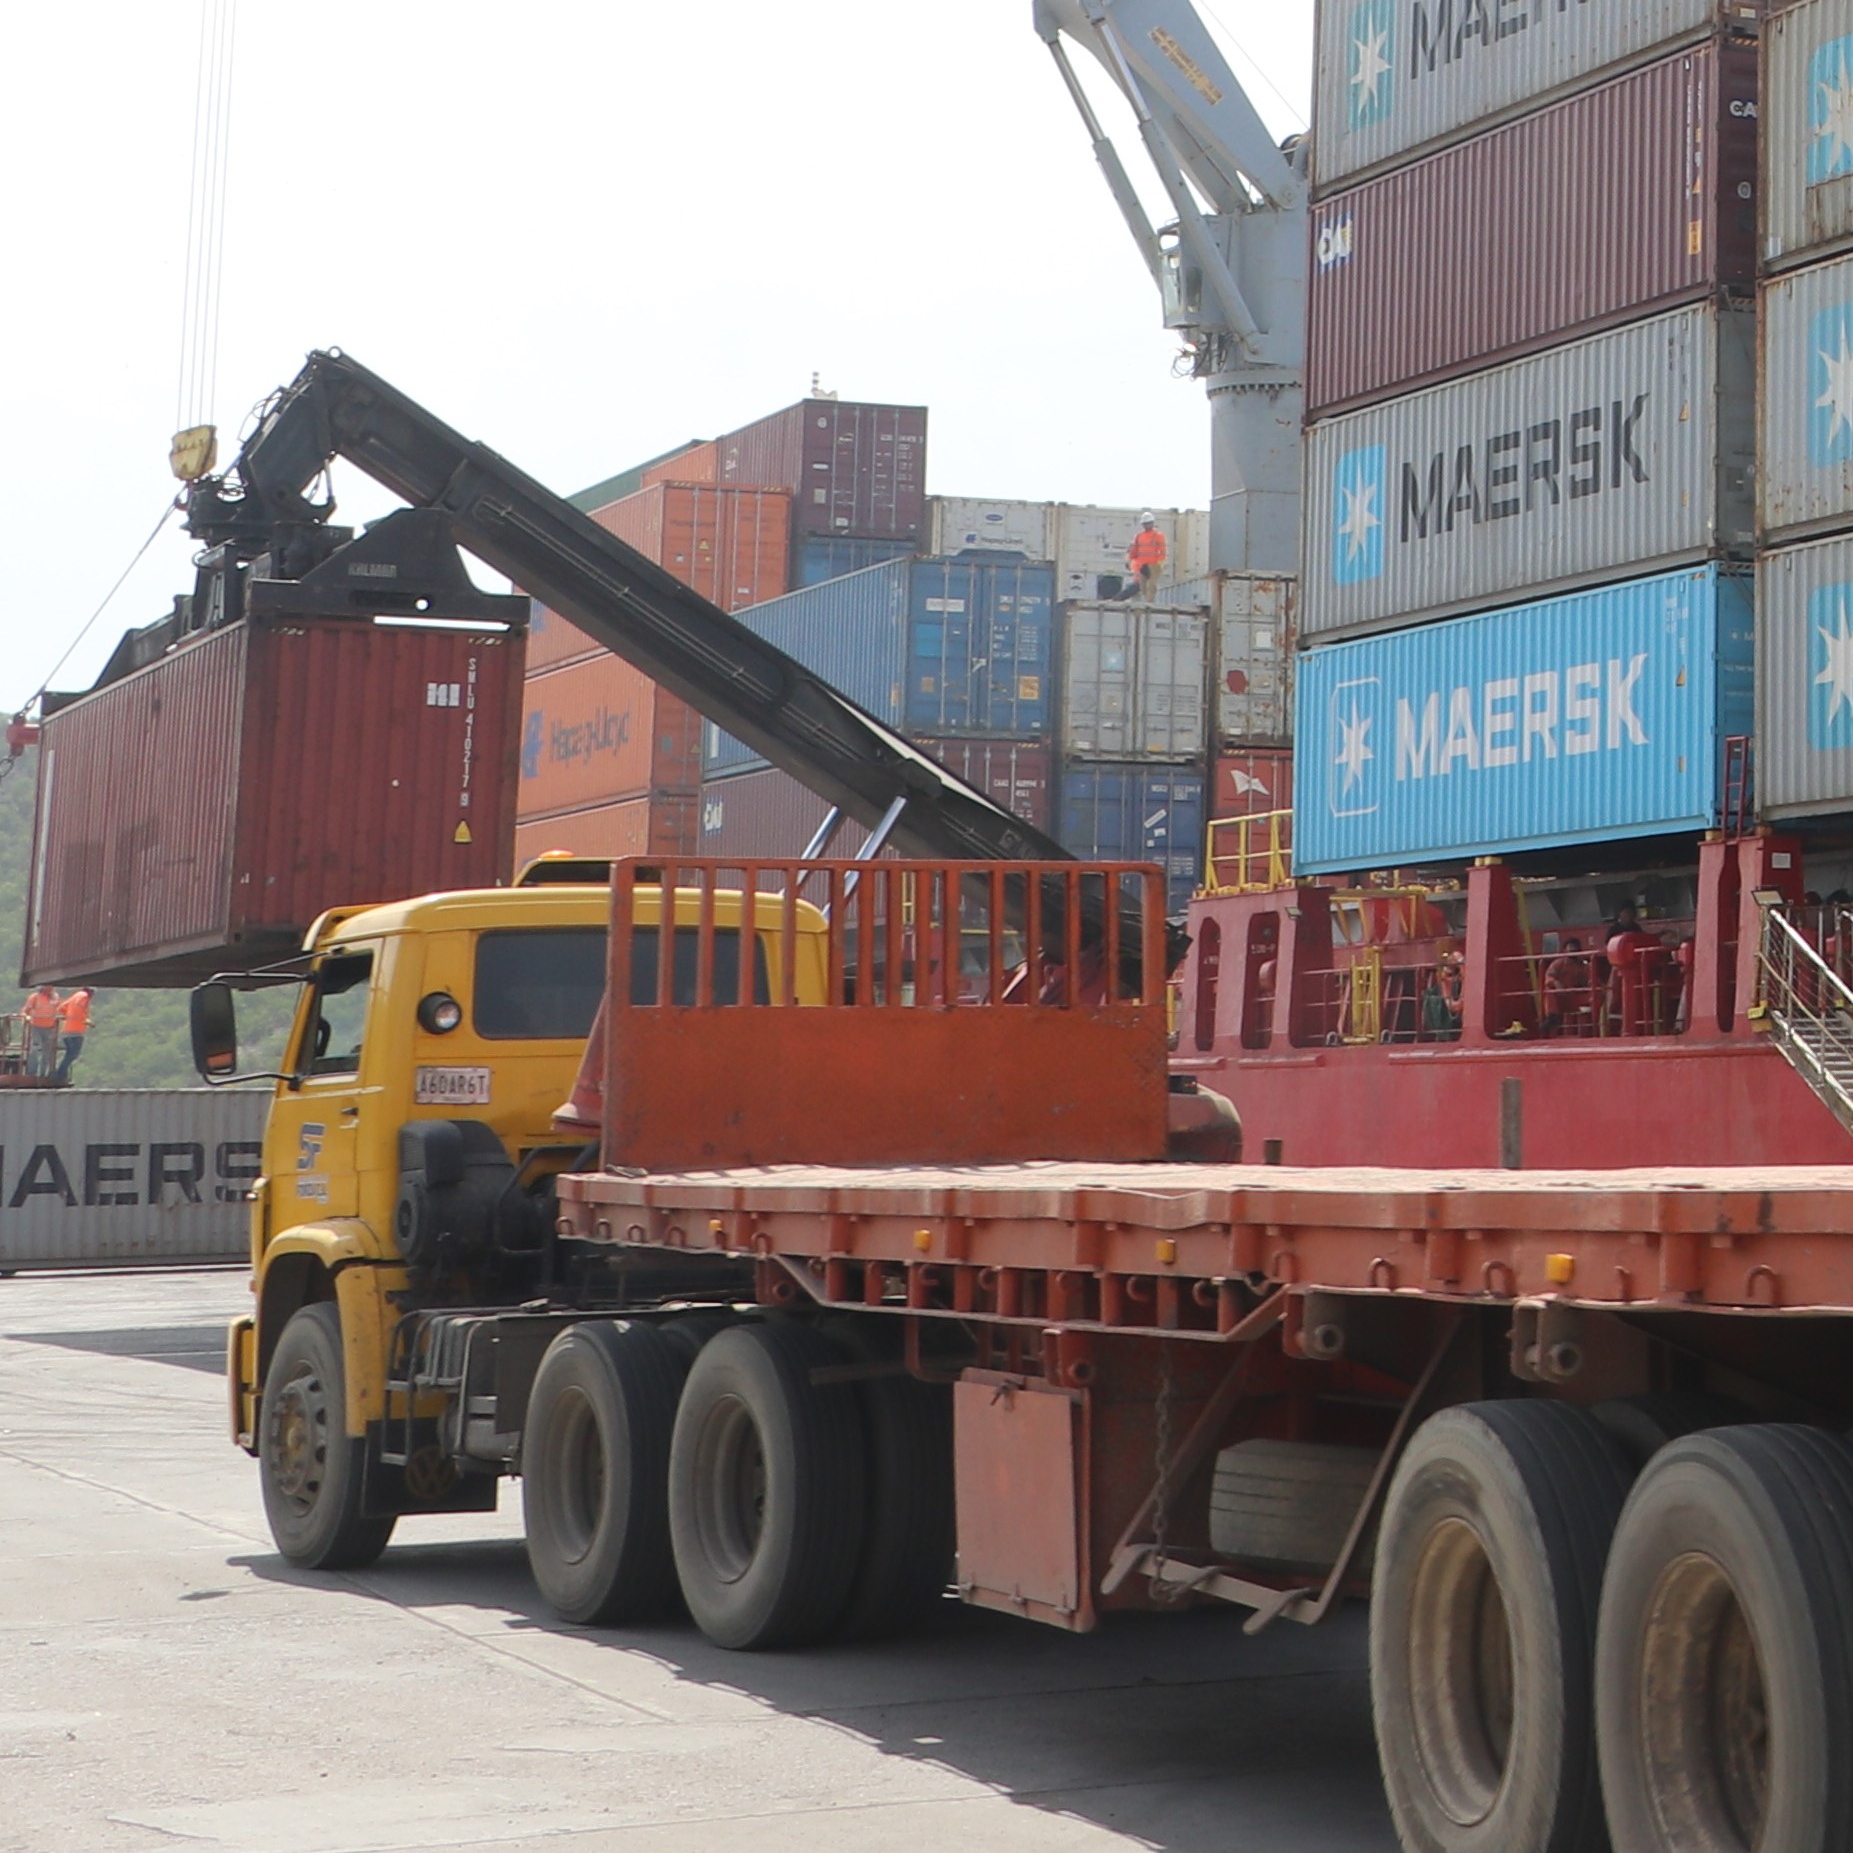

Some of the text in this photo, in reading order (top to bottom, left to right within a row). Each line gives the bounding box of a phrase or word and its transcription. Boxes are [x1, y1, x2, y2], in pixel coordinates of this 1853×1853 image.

[1729, 100, 1757, 119] CA
[1400, 392, 1651, 544] MAERSK
[1395, 652, 1651, 782] MAERSK
[0, 1141, 263, 1209] AERS
